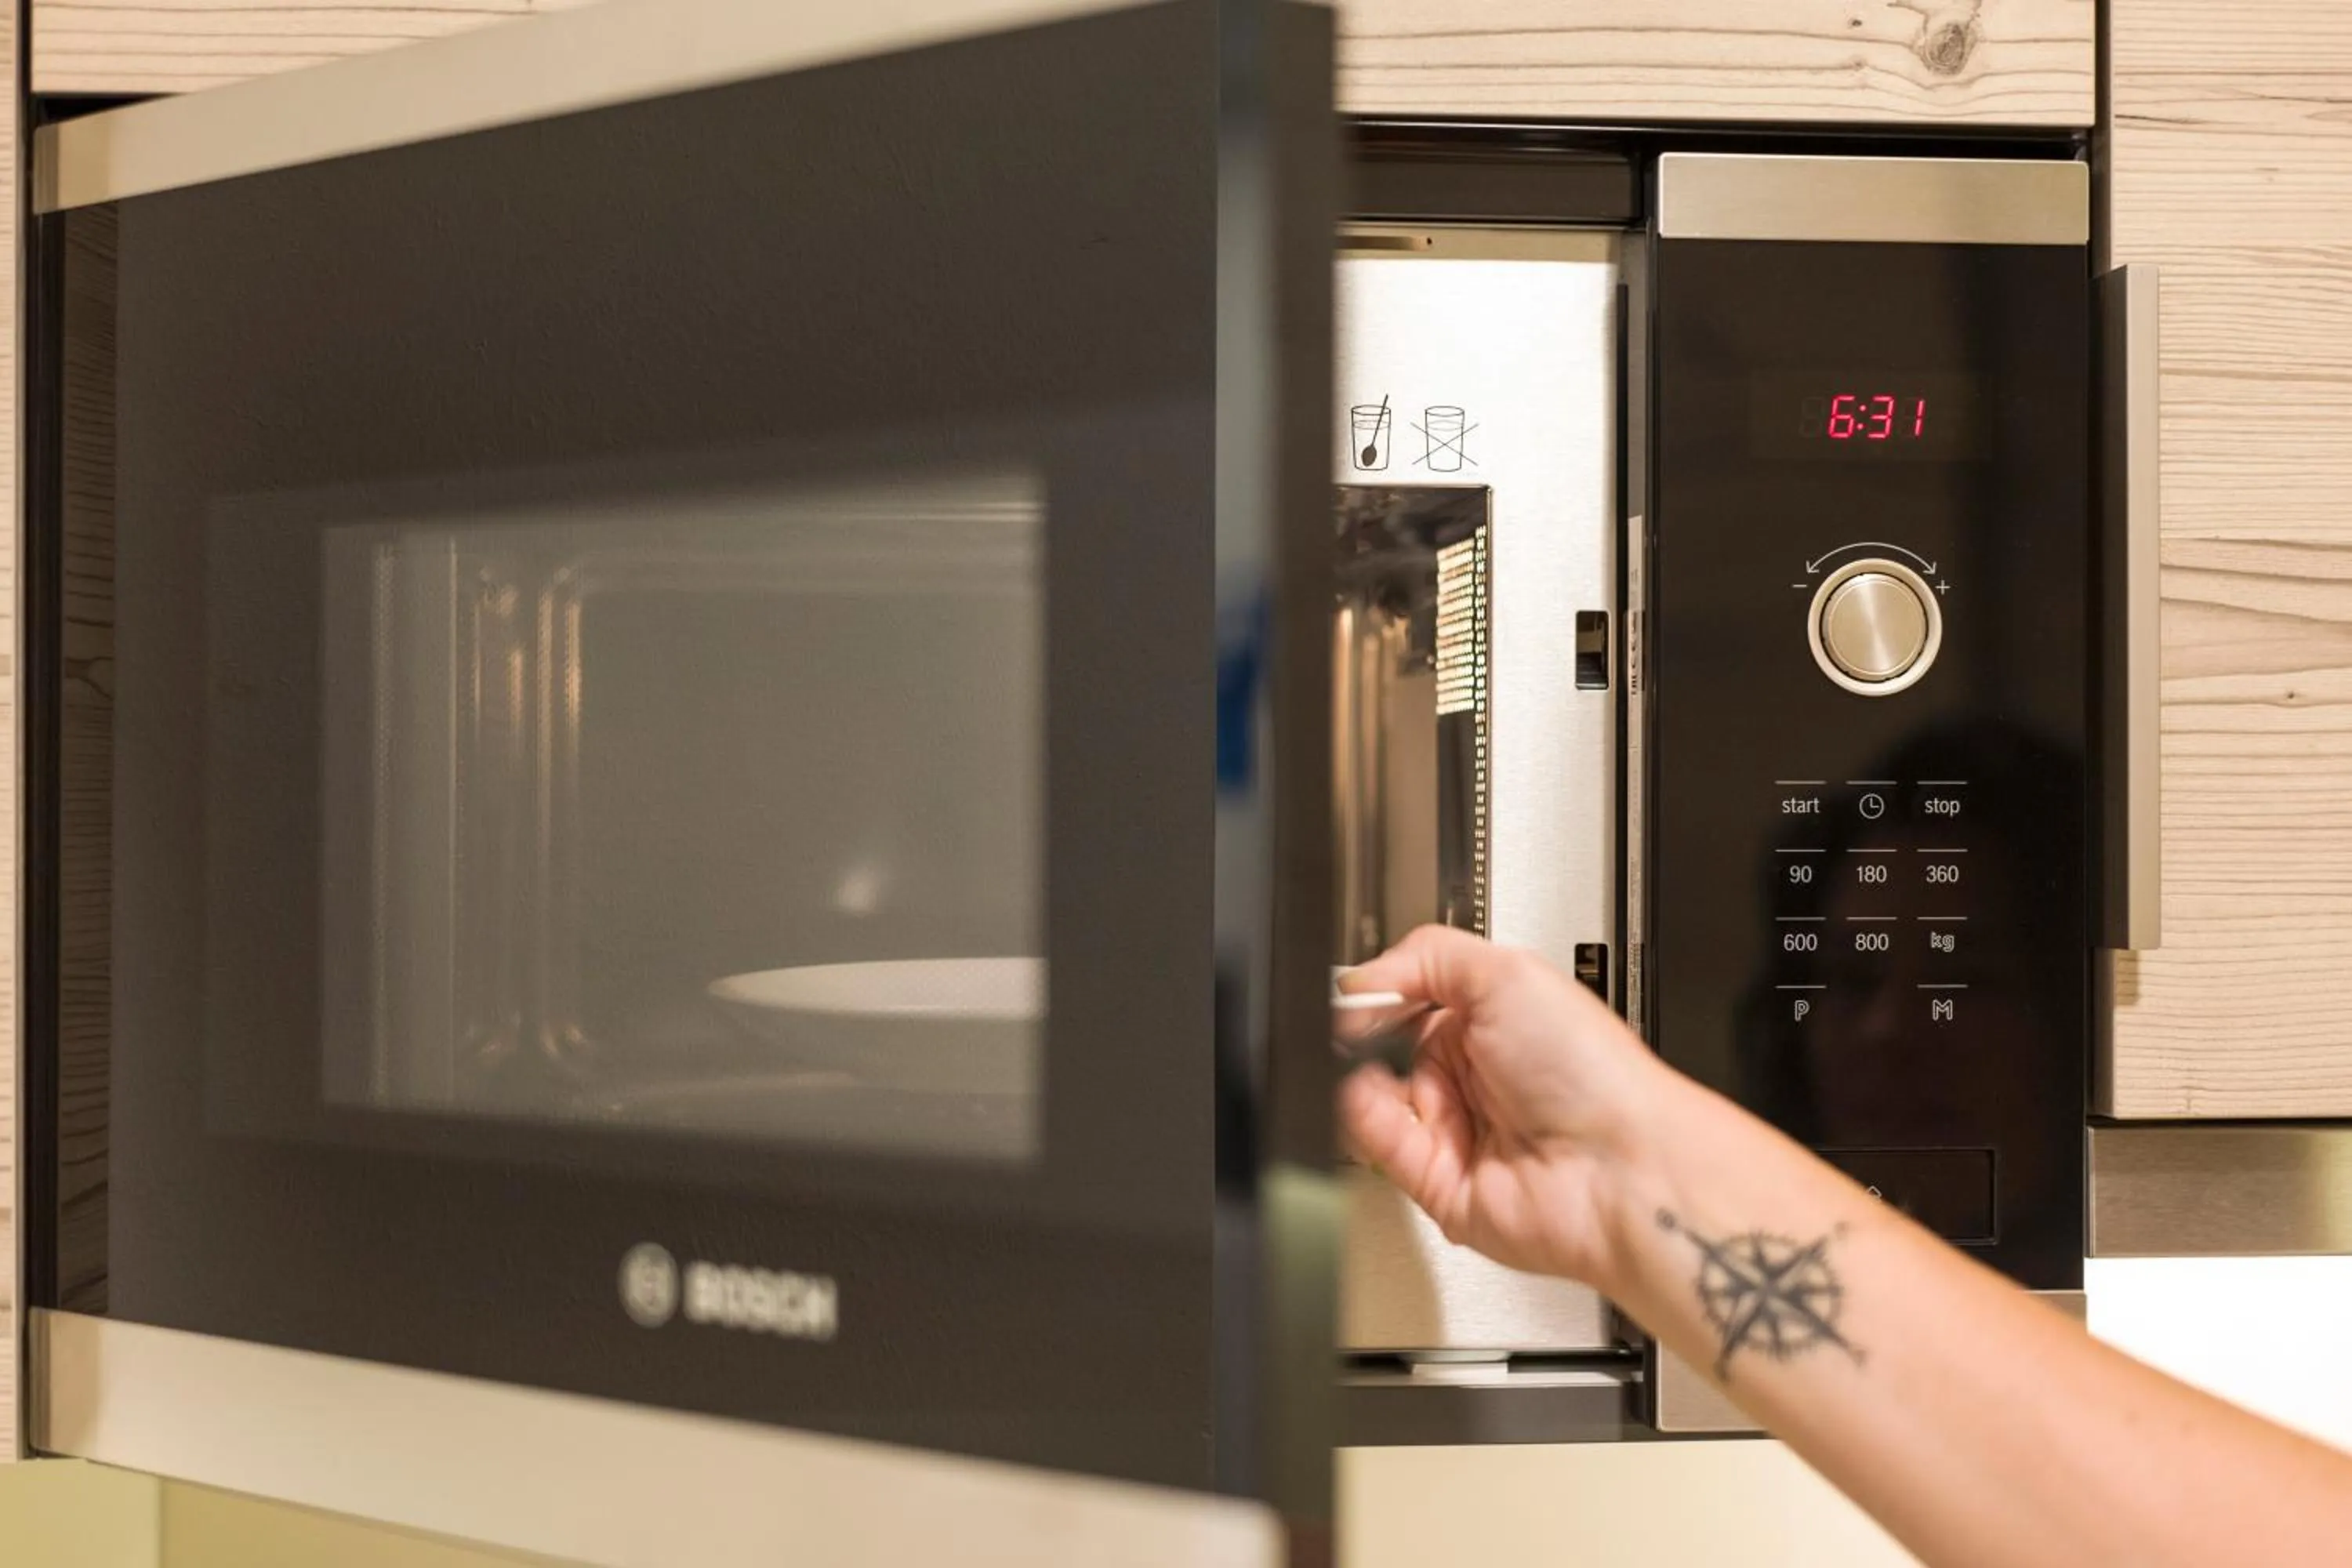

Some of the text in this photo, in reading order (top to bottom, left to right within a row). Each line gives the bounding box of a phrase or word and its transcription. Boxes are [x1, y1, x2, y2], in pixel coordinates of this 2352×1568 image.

[1828, 394, 1926, 439] 6:31
[1781, 797, 1820, 814] start
[1925, 797, 1961, 816] stop
[1789, 866, 1813, 883] 90
[1857, 866, 1887, 883] 180
[1926, 866, 1959, 883] 360
[1784, 934, 1818, 951] 600
[1855, 934, 1889, 951] 800
[1930, 931, 1955, 952] kg
[1795, 1000, 1809, 1022] P
[1933, 1000, 1953, 1020] M
[684, 1259, 837, 1341] BOSCH
